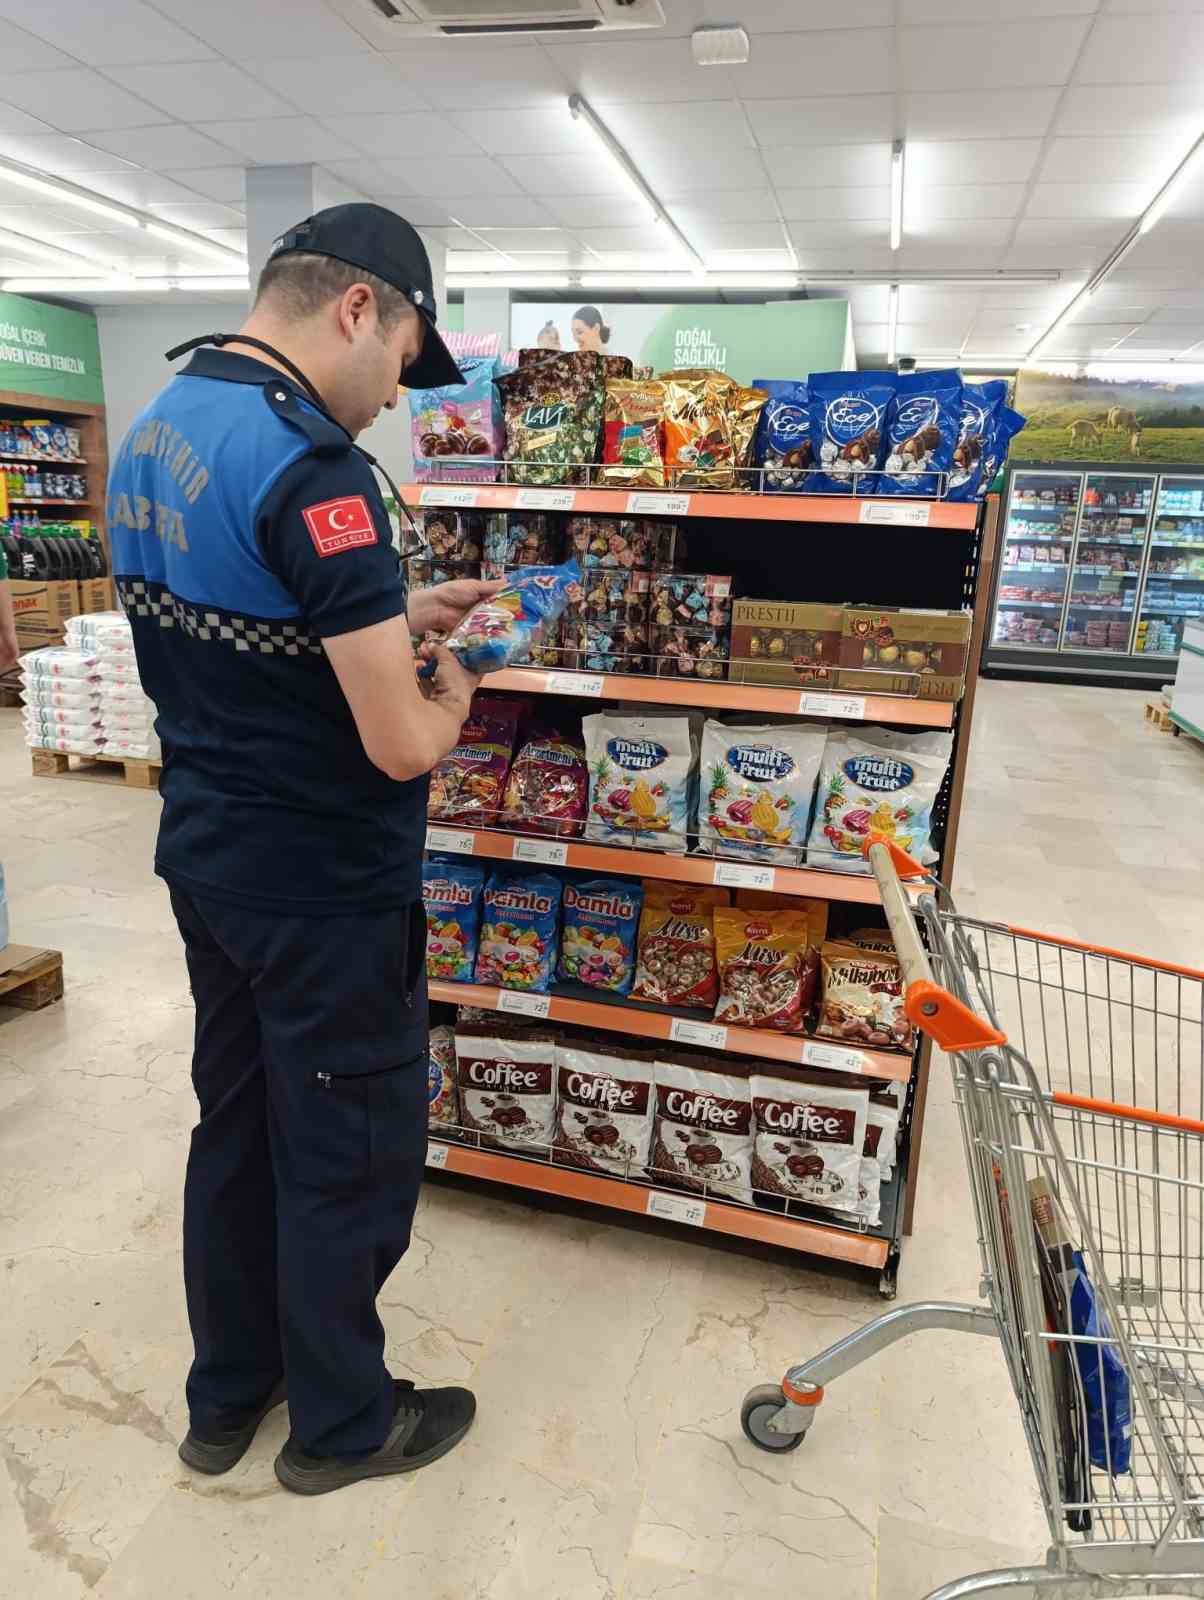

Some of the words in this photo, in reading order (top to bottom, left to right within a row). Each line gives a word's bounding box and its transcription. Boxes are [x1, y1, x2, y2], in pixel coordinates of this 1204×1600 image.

[854, 757, 902, 779] multi
[421, 881, 473, 905] amla
[563, 885, 634, 920] Damla
[469, 1061, 539, 1088] Coffee
[567, 1073, 635, 1106] Coffee
[666, 1091, 738, 1126] Coffee
[764, 1102, 840, 1134] Coffee
